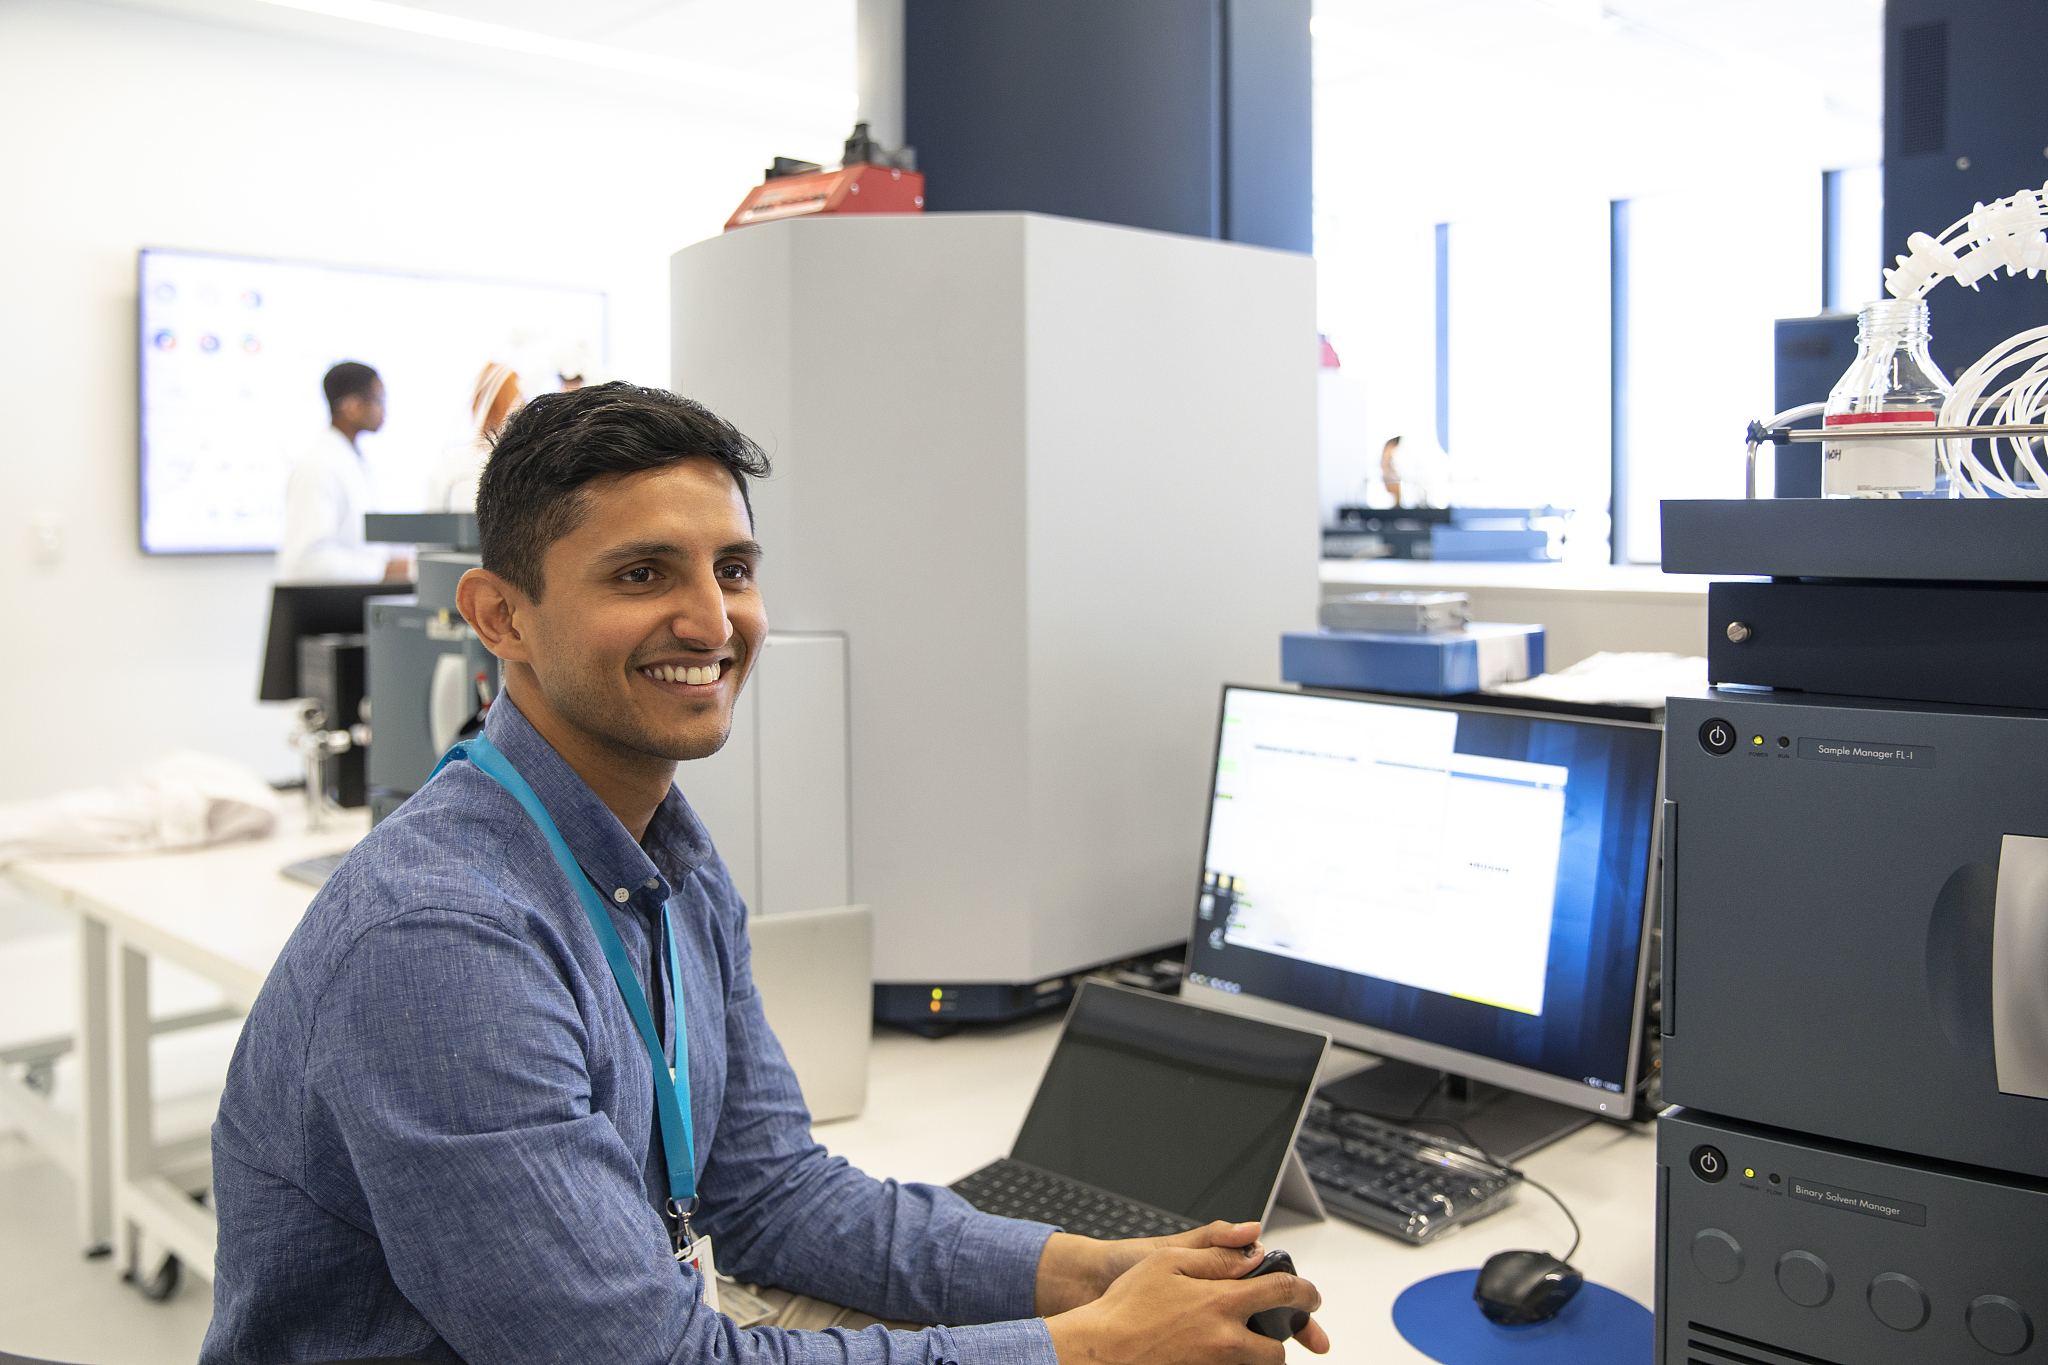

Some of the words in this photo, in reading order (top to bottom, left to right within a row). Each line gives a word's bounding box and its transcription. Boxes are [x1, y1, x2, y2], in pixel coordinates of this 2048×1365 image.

[1818, 744, 1851, 757] Sample
[1852, 747, 1894, 760] Manager
[1795, 1185, 1824, 1200] Binary
[1825, 1191, 1857, 1206] Solvent
[1859, 1199, 1901, 1215] Manager
